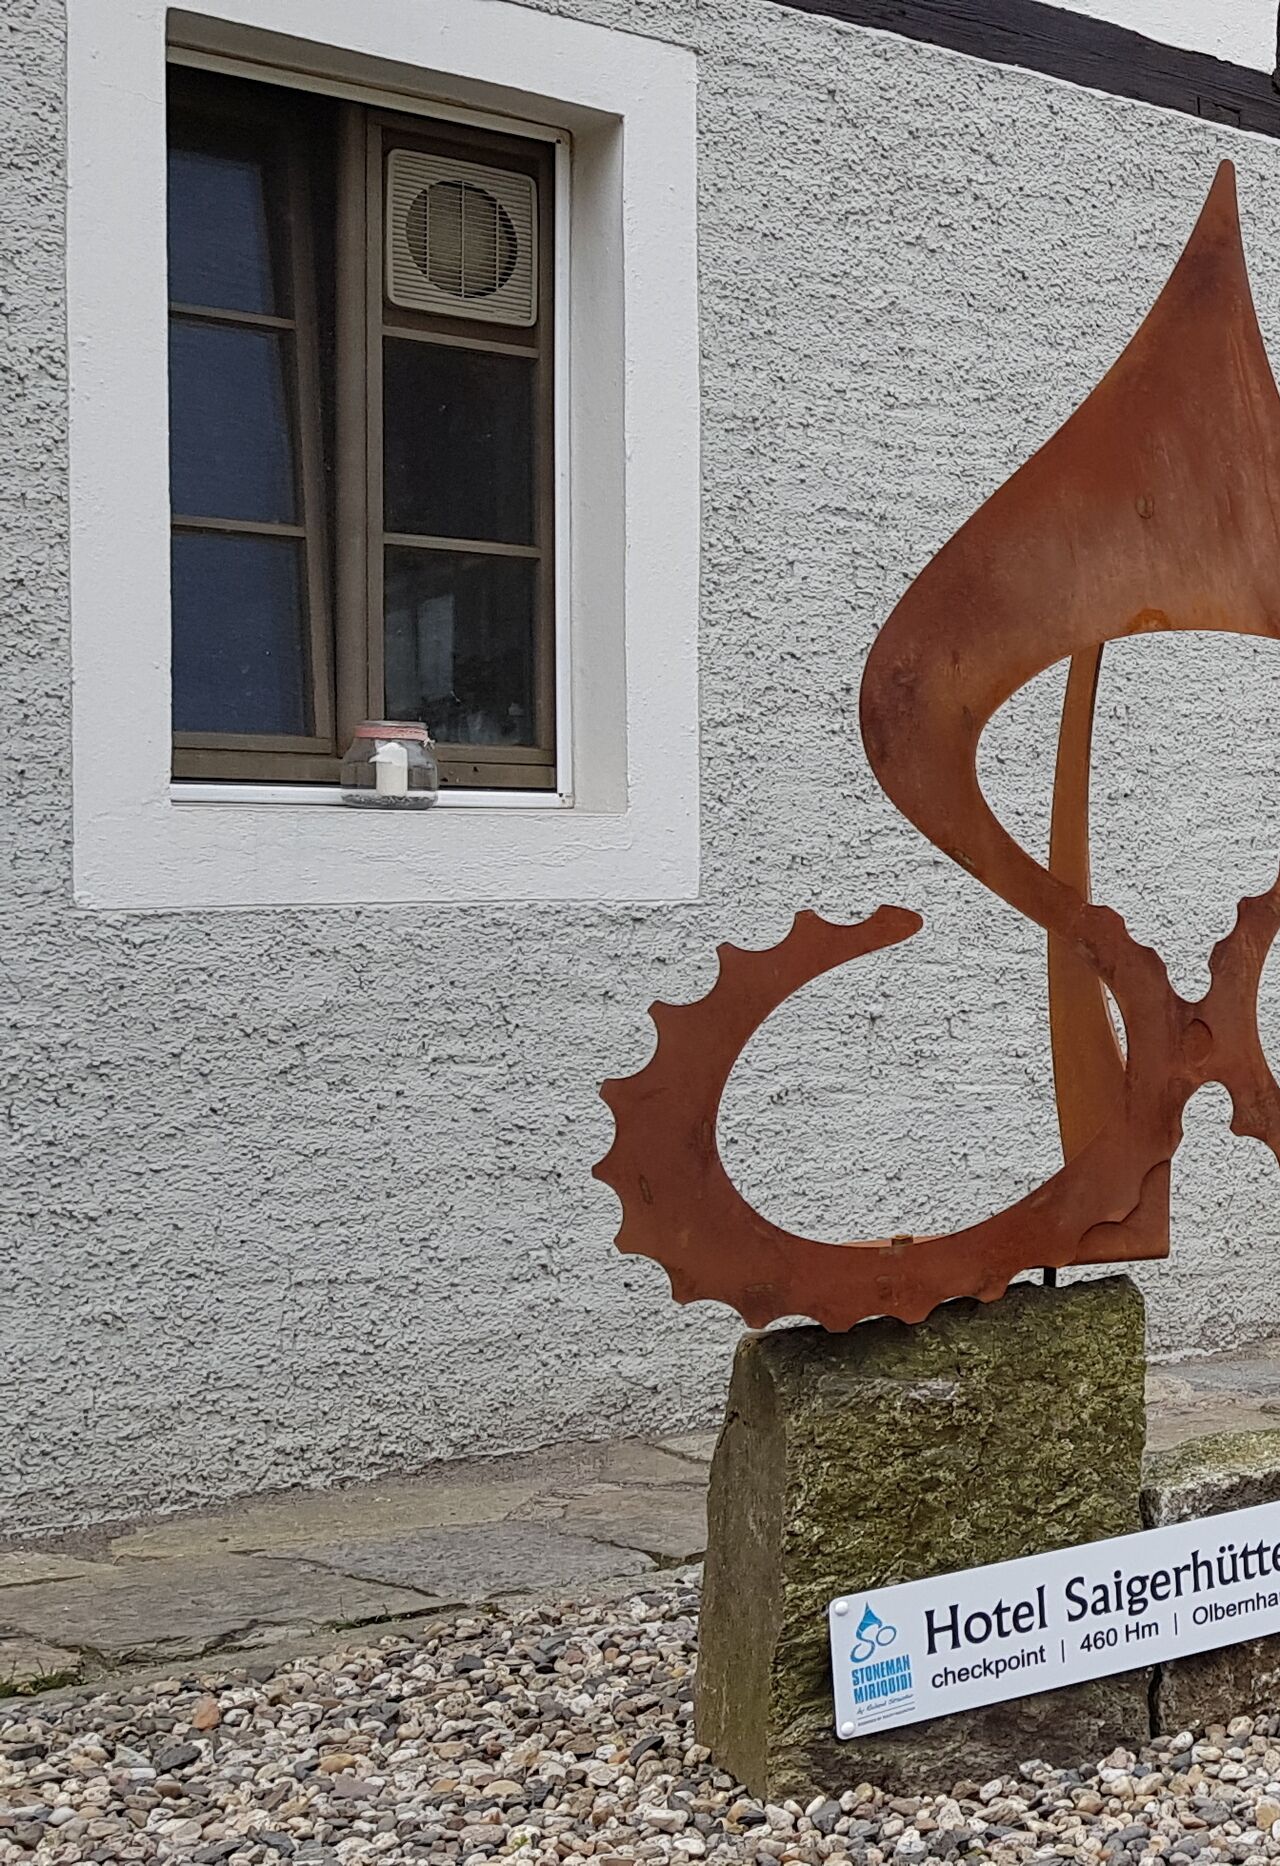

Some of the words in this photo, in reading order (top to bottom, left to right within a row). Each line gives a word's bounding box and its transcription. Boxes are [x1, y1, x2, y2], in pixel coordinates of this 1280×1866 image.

[924, 1584, 1049, 1655] Hotel
[851, 1653, 911, 1687] STONEMAN
[931, 1645, 1046, 1689] checkpoint
[1079, 1628, 1119, 1653] 460
[1125, 1620, 1160, 1643] Hm
[853, 1672, 913, 1705] MIRIQUIDI
